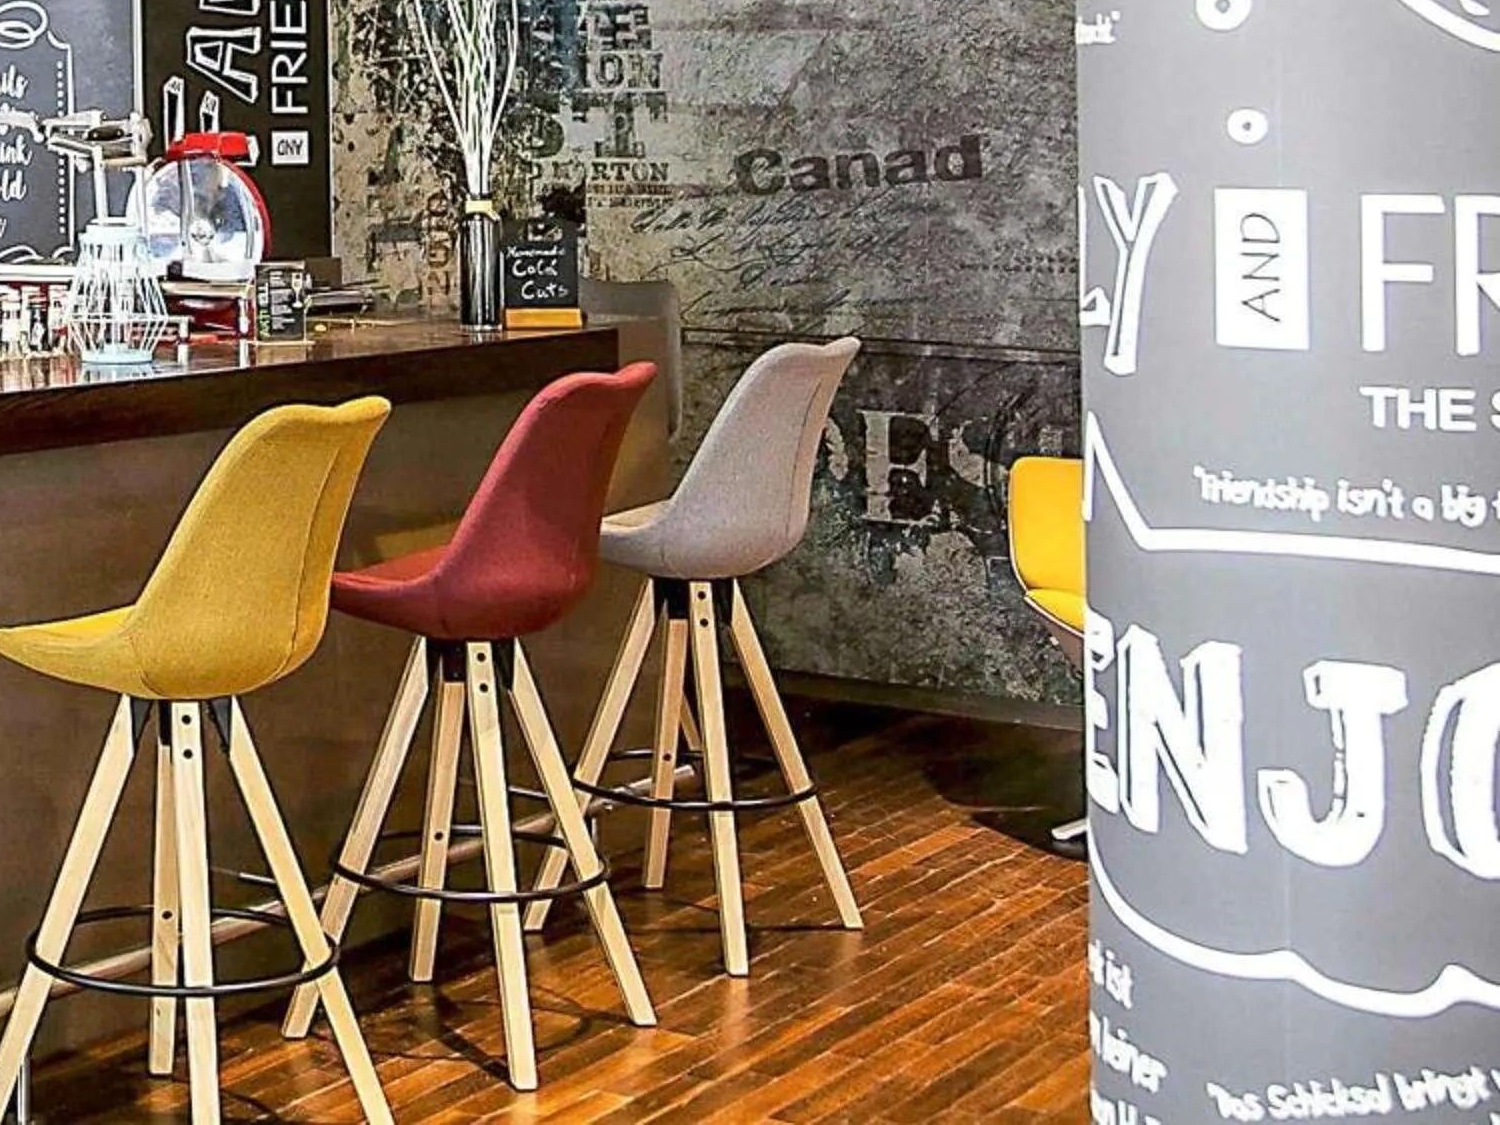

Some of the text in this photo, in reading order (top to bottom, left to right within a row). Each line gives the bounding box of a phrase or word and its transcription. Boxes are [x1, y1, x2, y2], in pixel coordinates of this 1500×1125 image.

[277, 136, 304, 158] AND
[733, 134, 984, 196] Canad
[521, 280, 569, 300] Cuts
[1240, 212, 1281, 323] AND
[1359, 386, 1477, 432] THE
[1337, 477, 1404, 519] isn't
[1412, 495, 1434, 521] a
[1441, 484, 1487, 527] big
